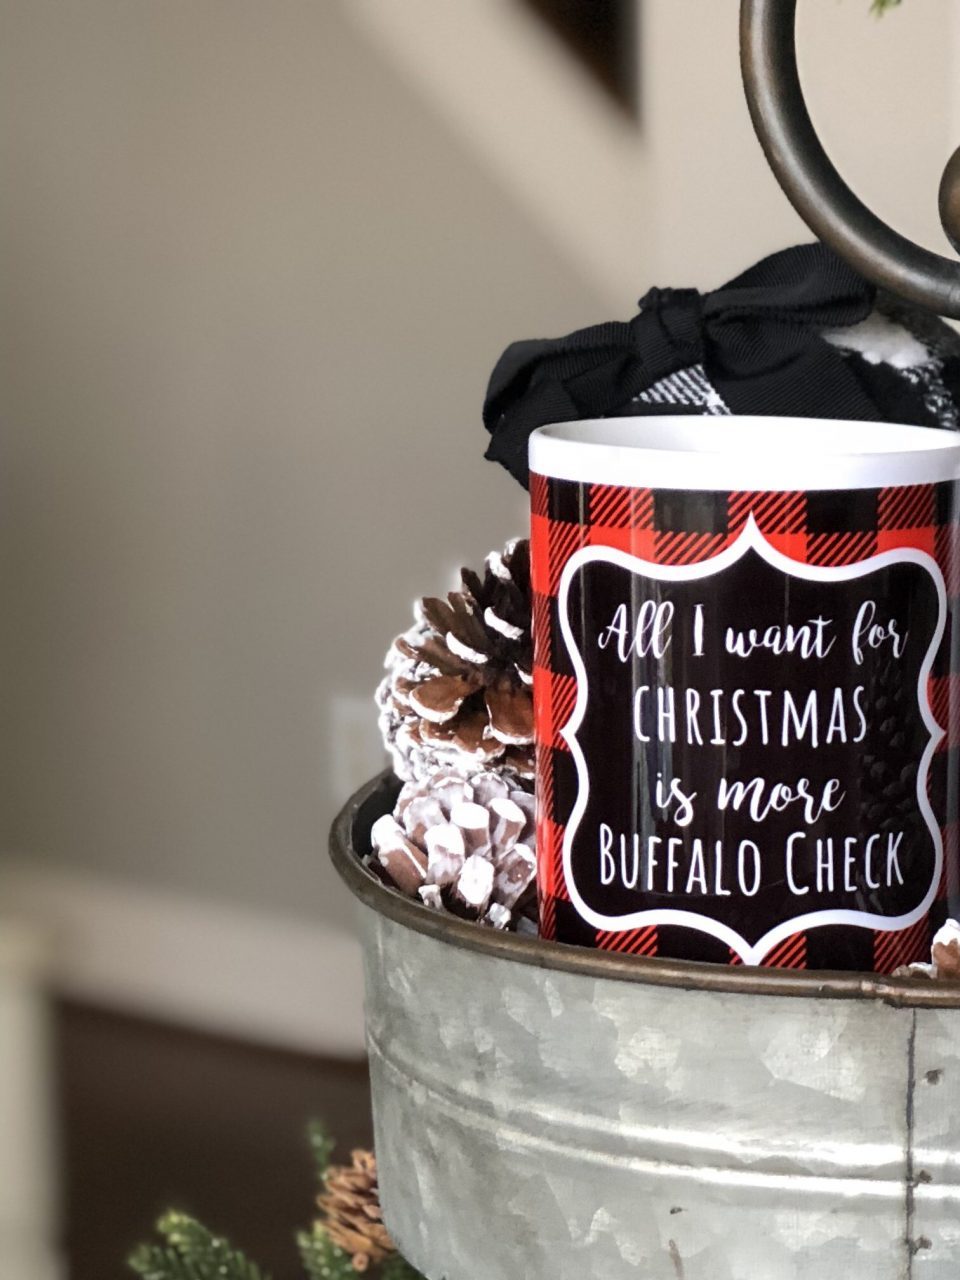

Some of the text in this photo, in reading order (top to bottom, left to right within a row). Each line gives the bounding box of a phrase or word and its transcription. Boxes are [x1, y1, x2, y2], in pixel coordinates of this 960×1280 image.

[598, 600, 909, 665] All I want for
[633, 685, 868, 748] CHRISTMAS
[655, 772, 847, 827] is more
